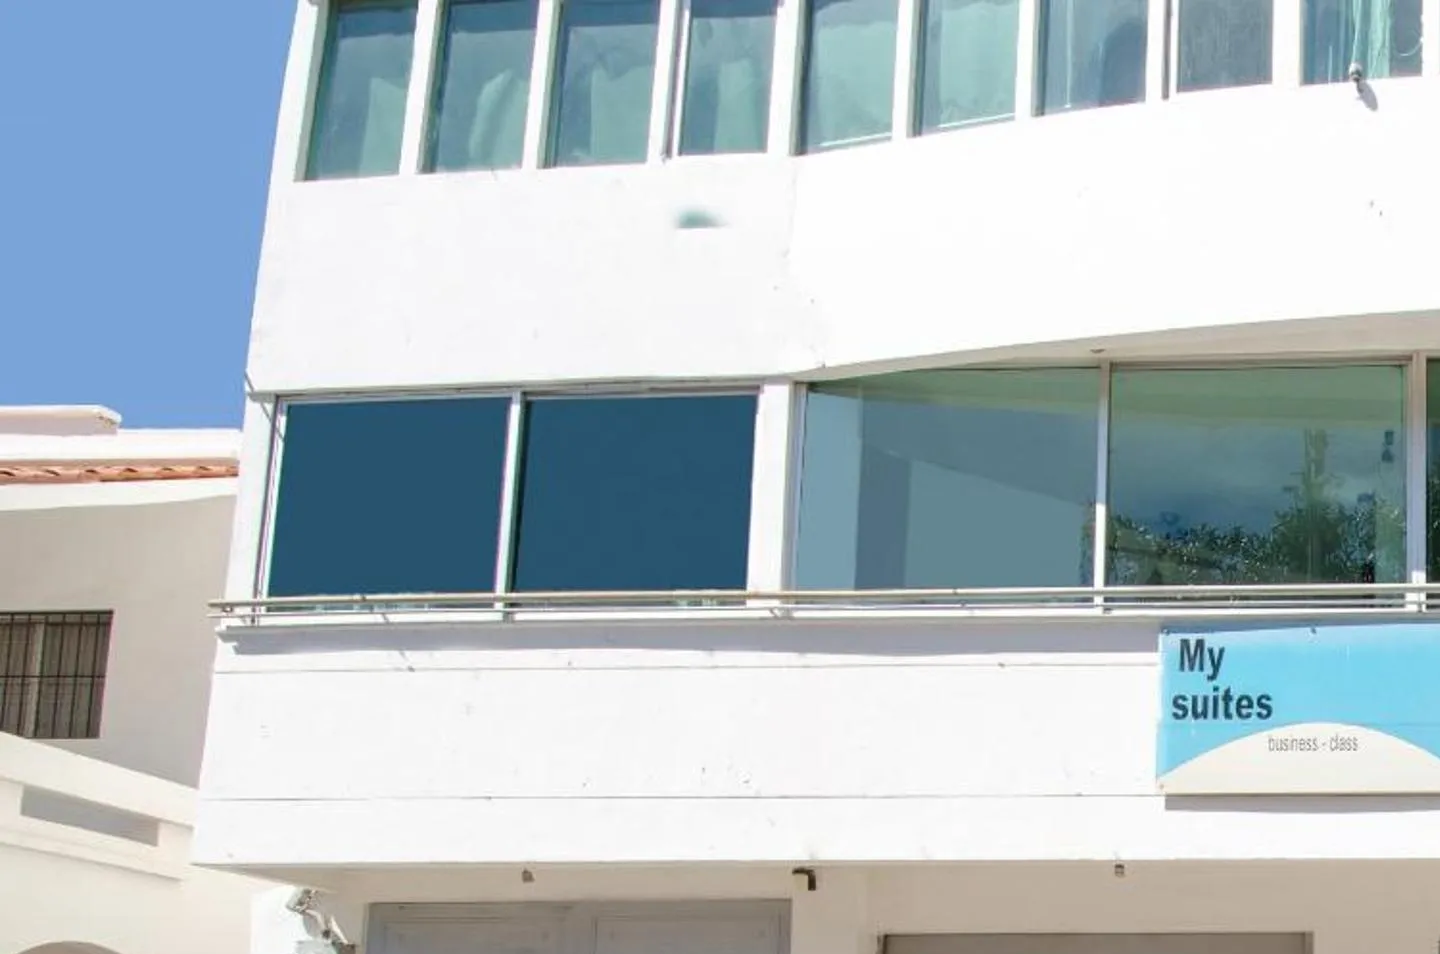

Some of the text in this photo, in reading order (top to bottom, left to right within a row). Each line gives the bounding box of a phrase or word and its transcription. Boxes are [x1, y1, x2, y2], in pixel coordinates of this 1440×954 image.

[1178, 638, 1226, 681] My
[1171, 684, 1274, 721] suites
[1268, 734, 1319, 752] business
[1329, 733, 1359, 752] class
